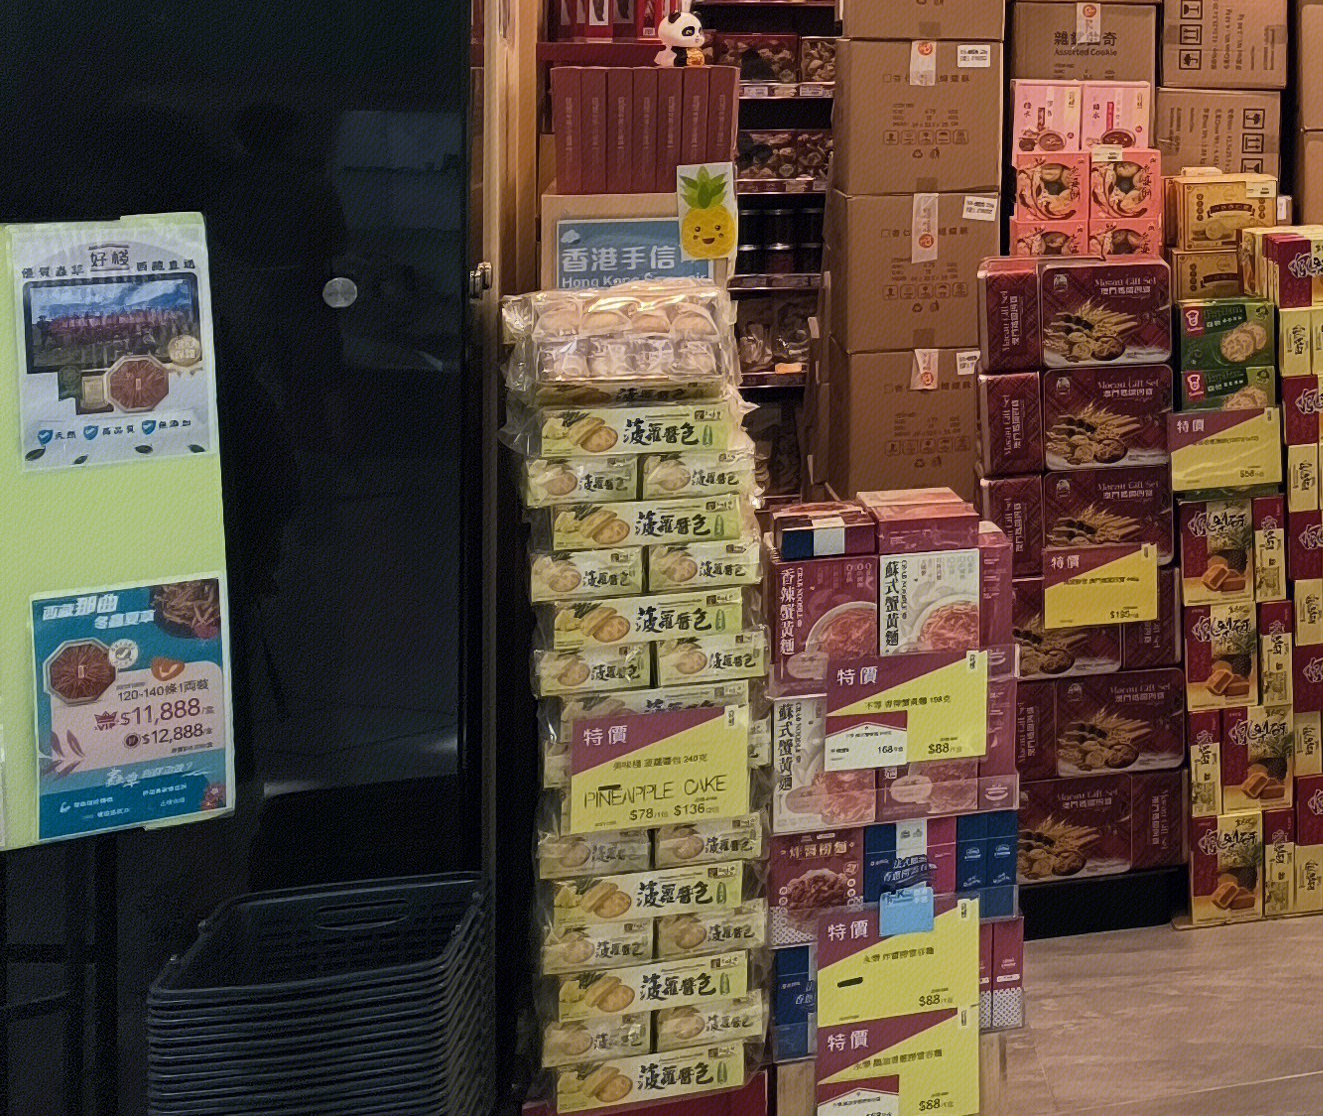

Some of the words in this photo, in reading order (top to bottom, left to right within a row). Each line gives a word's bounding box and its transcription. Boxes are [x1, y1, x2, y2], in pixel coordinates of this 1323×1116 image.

[561, 245, 676, 273] 香港手信
[837, 665, 878, 686] 特價
[583, 724, 628, 747] 特價
[584, 781, 675, 809] PINEAPPLE
[684, 774, 728, 796] CAKE
[828, 919, 869, 942] 特價
[828, 1029, 869, 1052] 特價
